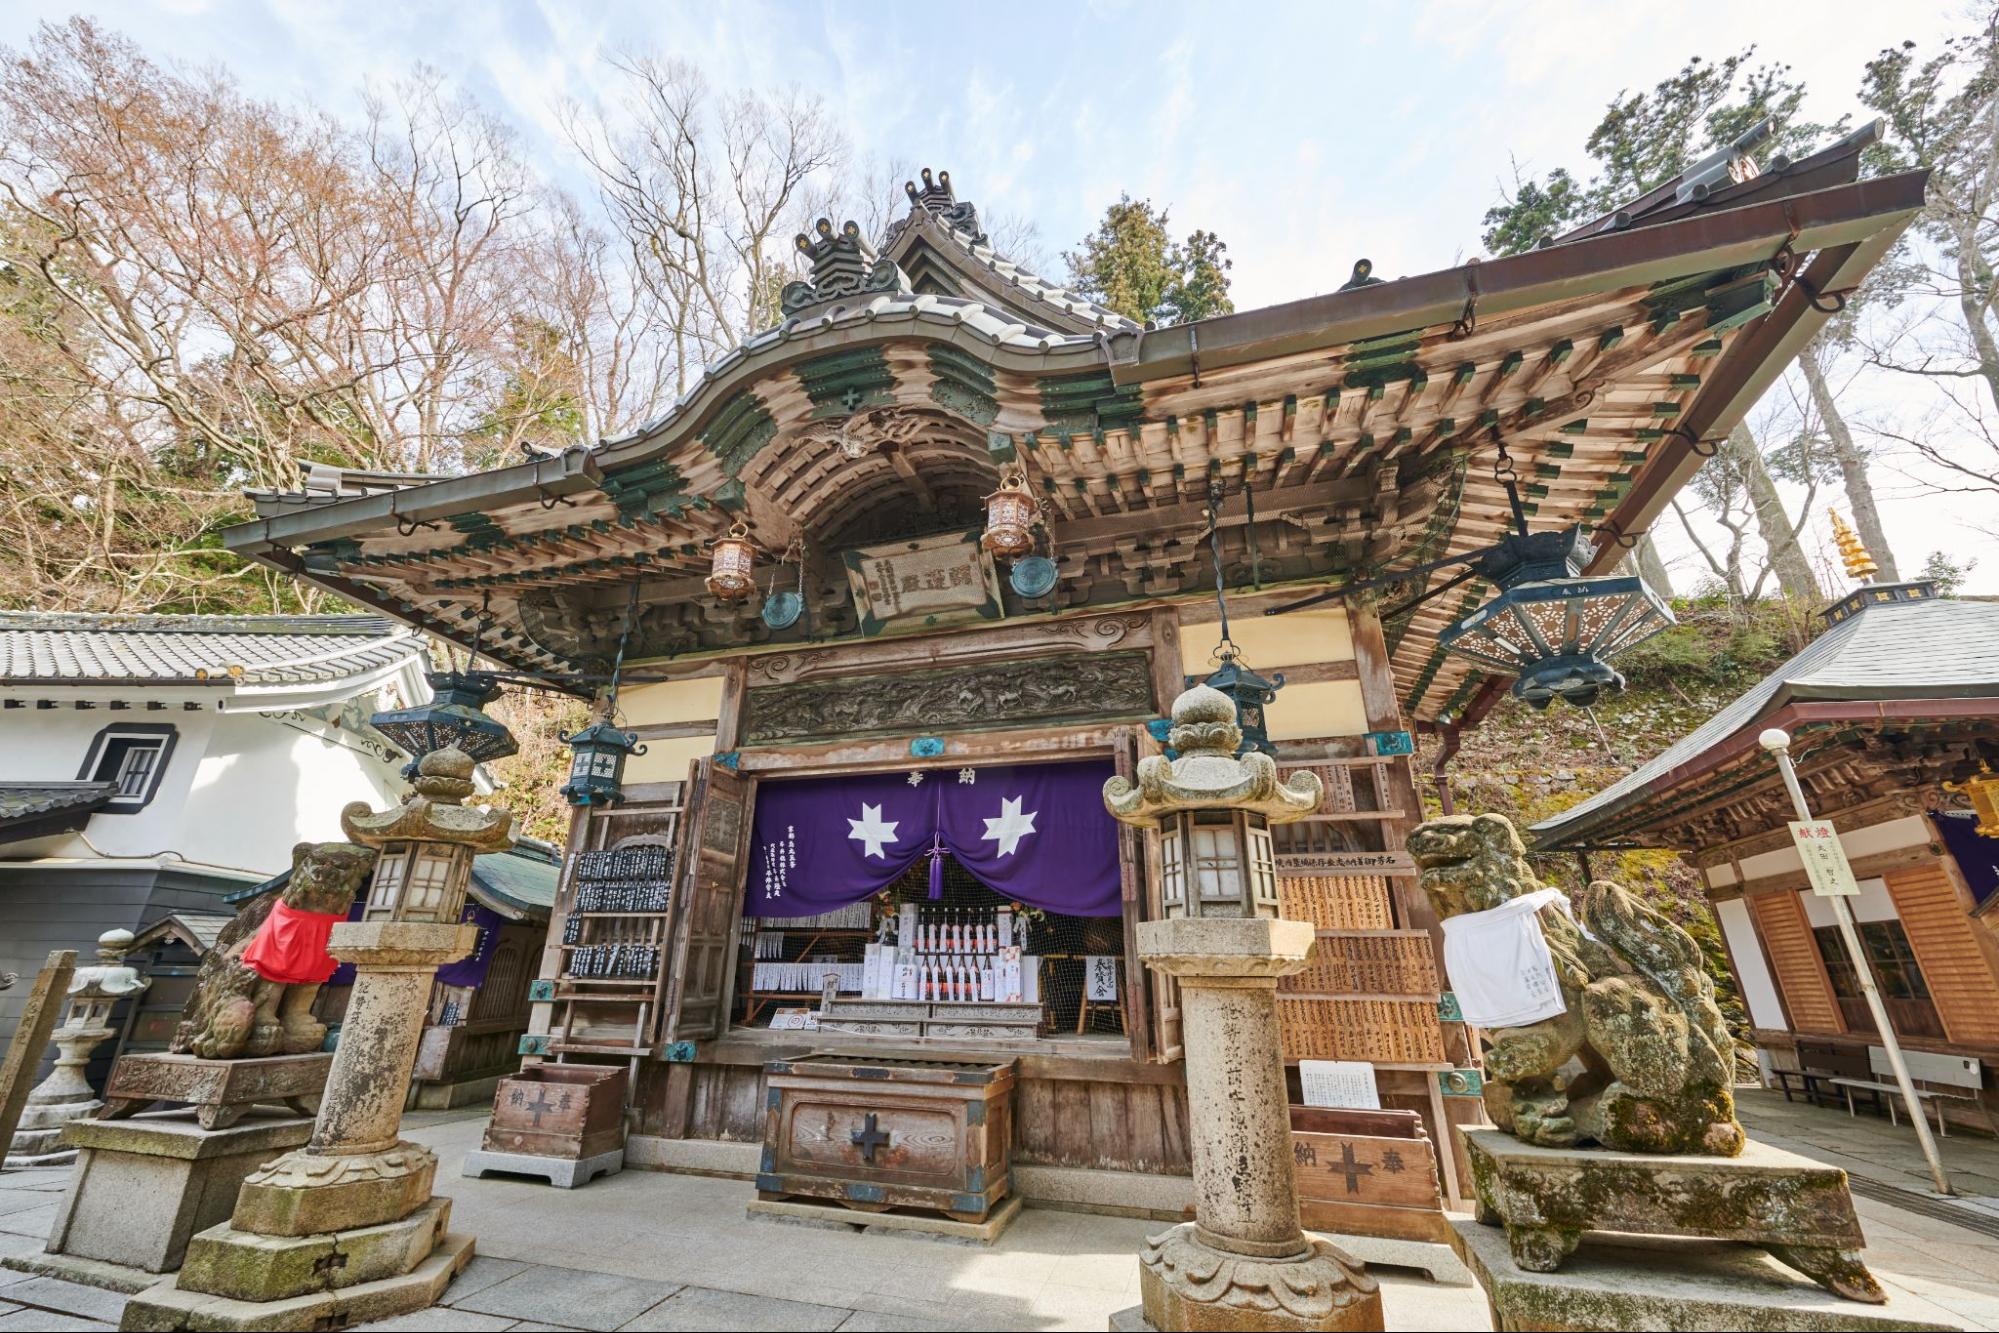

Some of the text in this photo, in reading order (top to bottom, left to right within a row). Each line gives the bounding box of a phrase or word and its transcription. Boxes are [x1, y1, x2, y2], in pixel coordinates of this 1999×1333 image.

[907, 767, 976, 788] 奉 納
[510, 1087, 572, 1112] 奉 納
[1295, 1141, 1406, 1174] 奉 納
